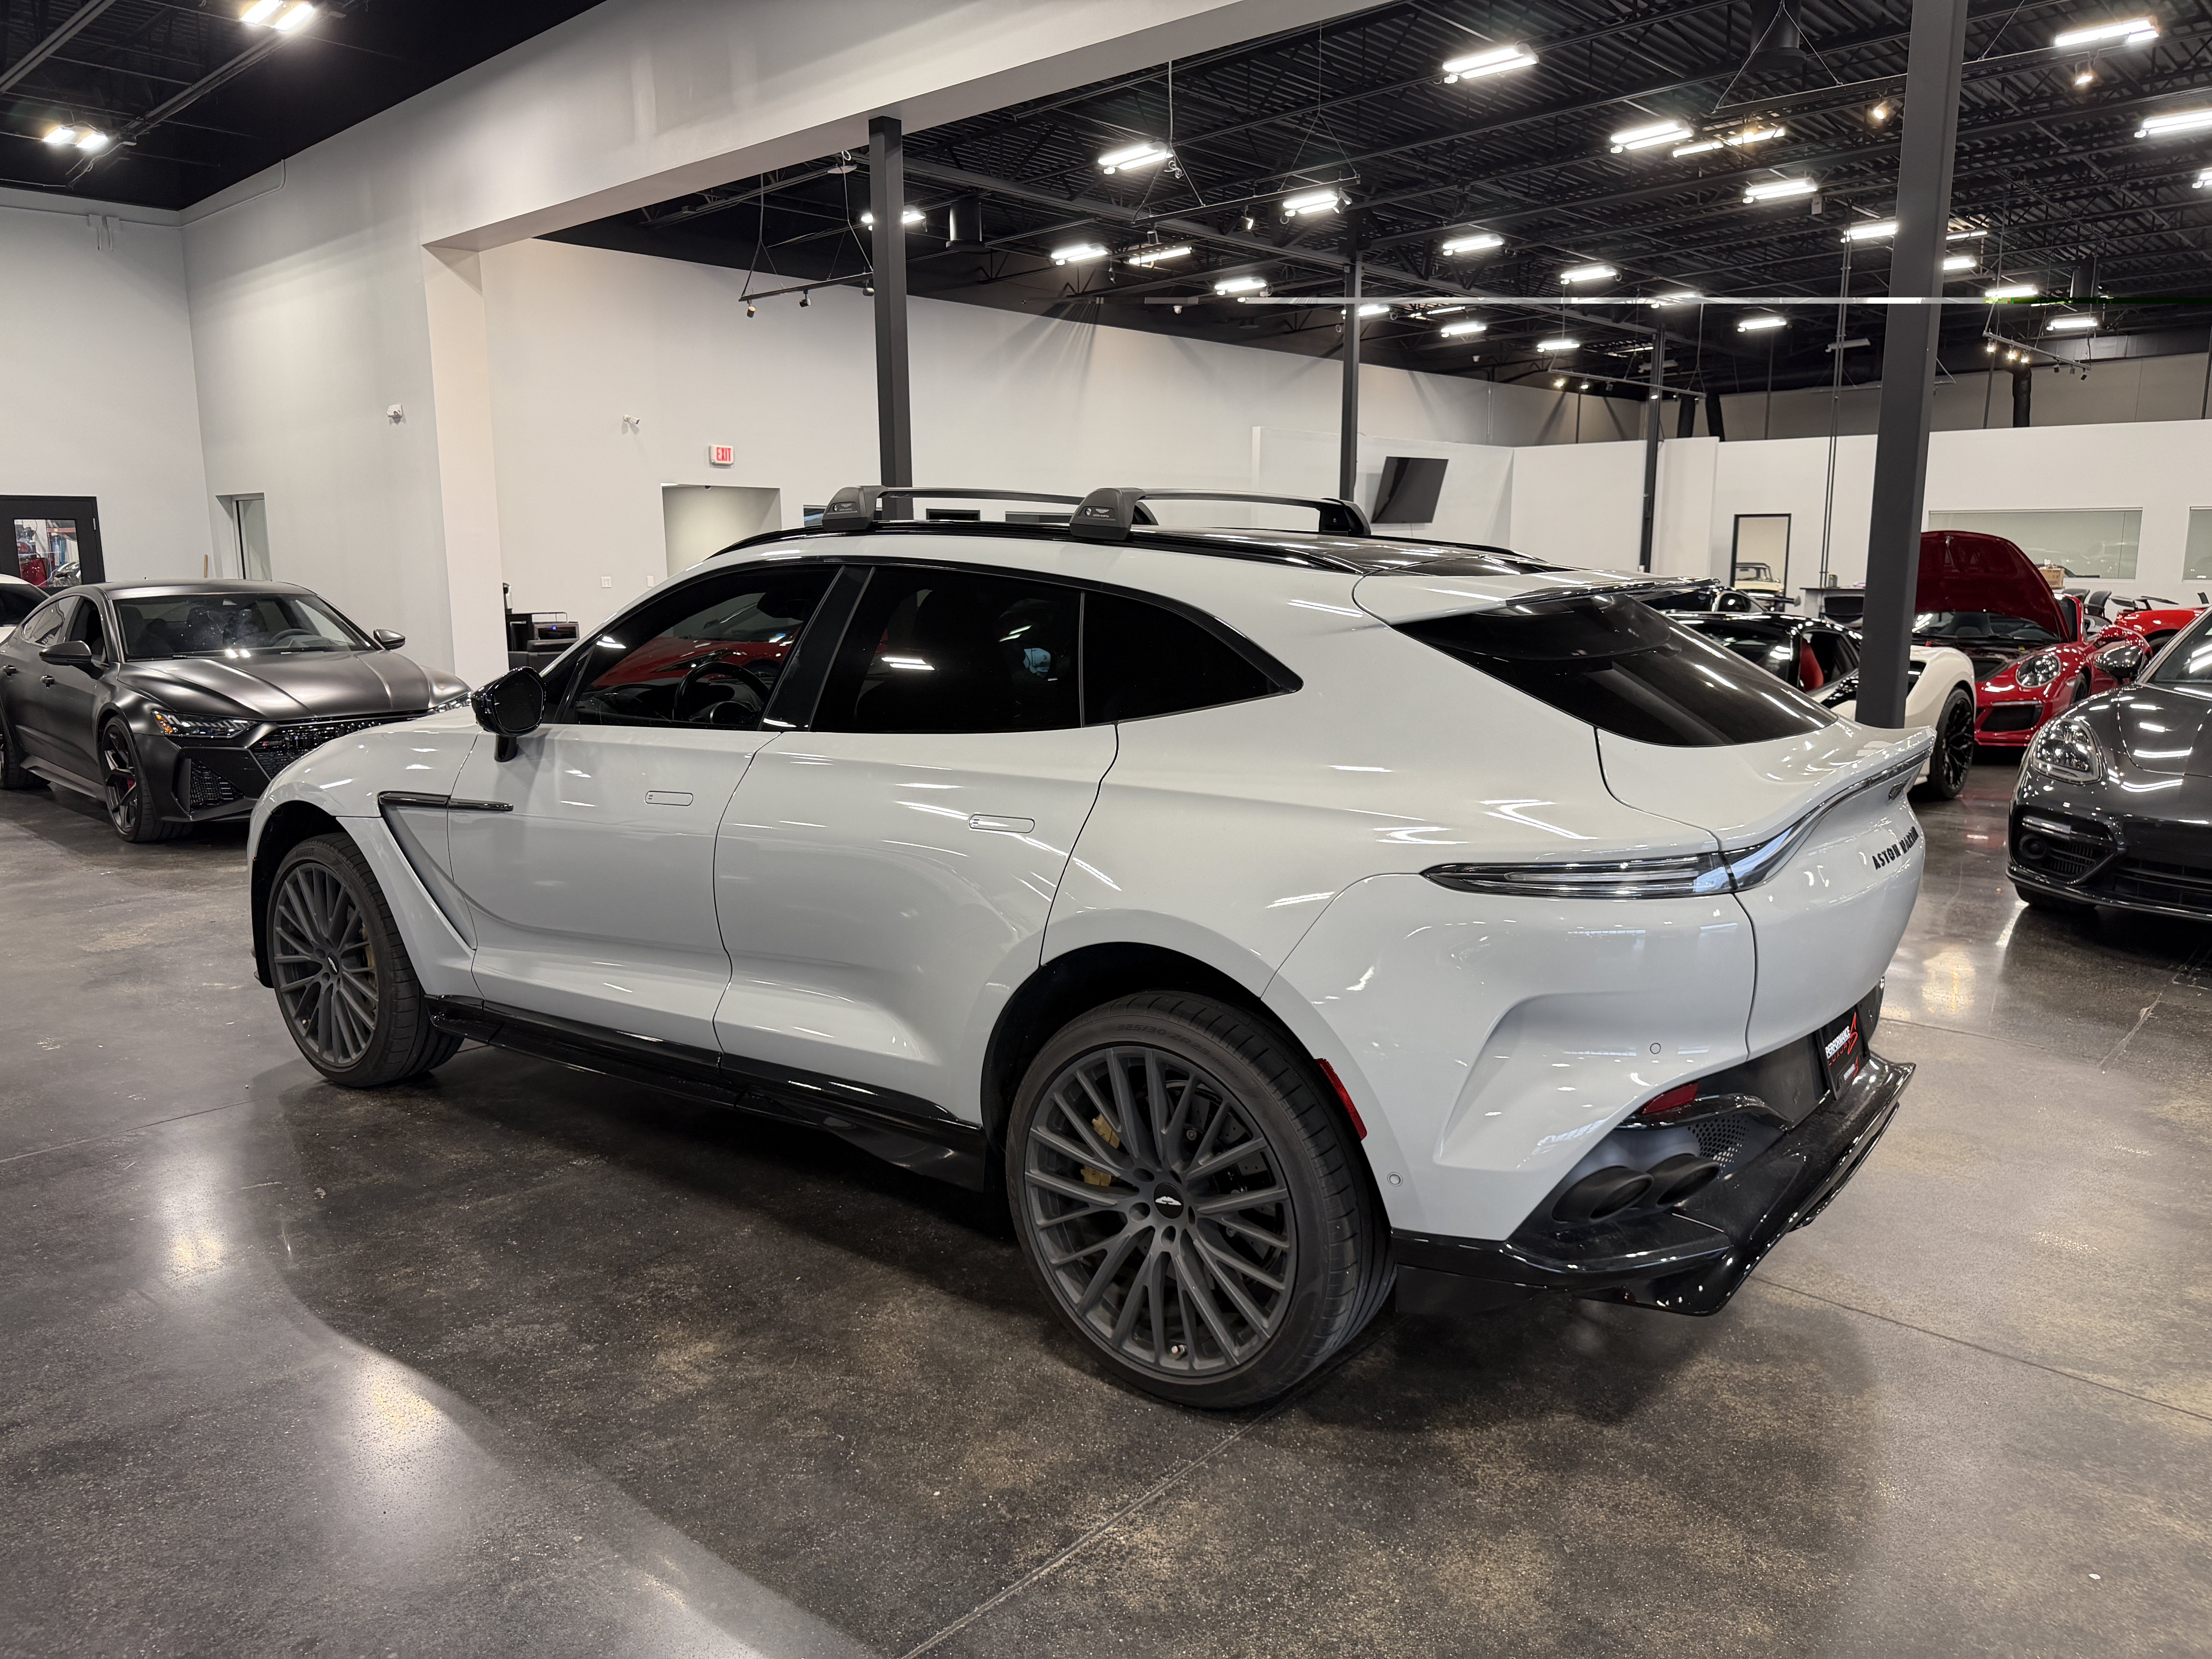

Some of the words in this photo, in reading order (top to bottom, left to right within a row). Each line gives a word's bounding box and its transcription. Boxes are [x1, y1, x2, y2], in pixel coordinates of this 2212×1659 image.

[716, 447, 732, 462] EXIT
[1872, 843, 1901, 870] ASTON
[1827, 1038, 1853, 1066] LUXURY
